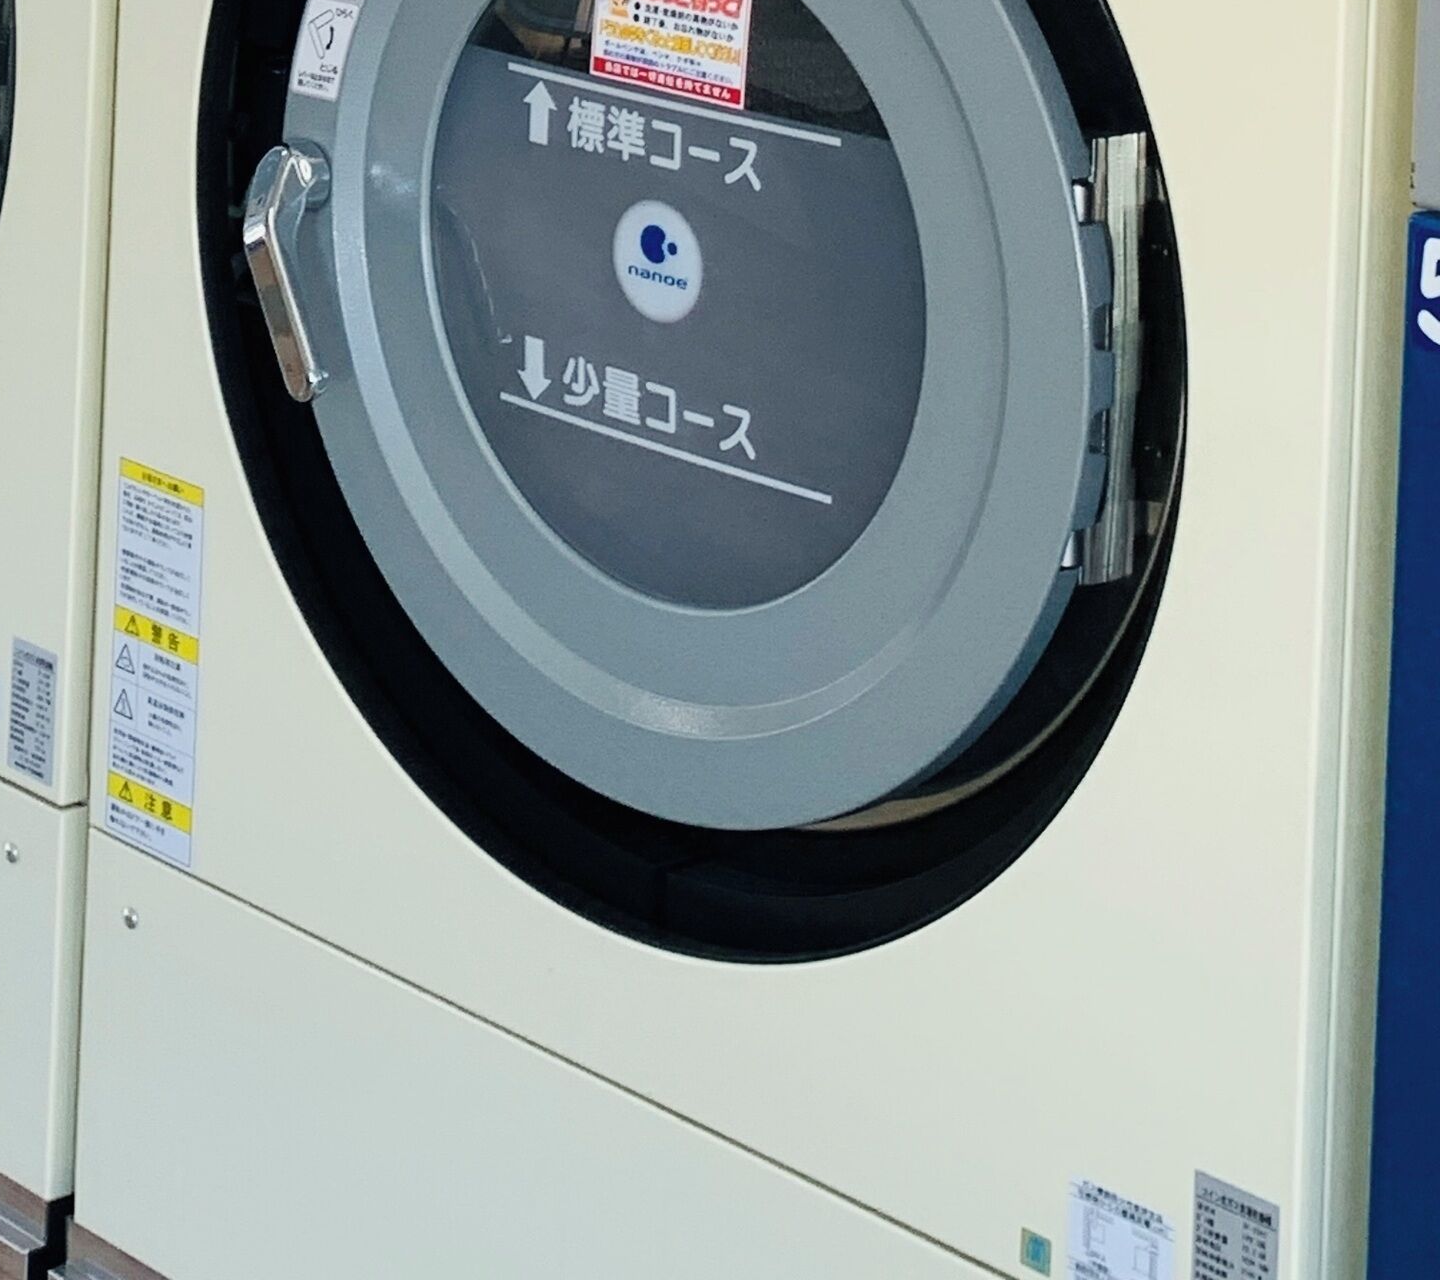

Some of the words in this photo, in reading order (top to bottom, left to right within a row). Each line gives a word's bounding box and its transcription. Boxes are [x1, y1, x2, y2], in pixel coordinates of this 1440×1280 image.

[567, 95, 763, 192] 標準コース
[627, 264, 689, 290] nanoe
[562, 355, 757, 460] 少量コース
[144, 792, 173, 821] 注意
